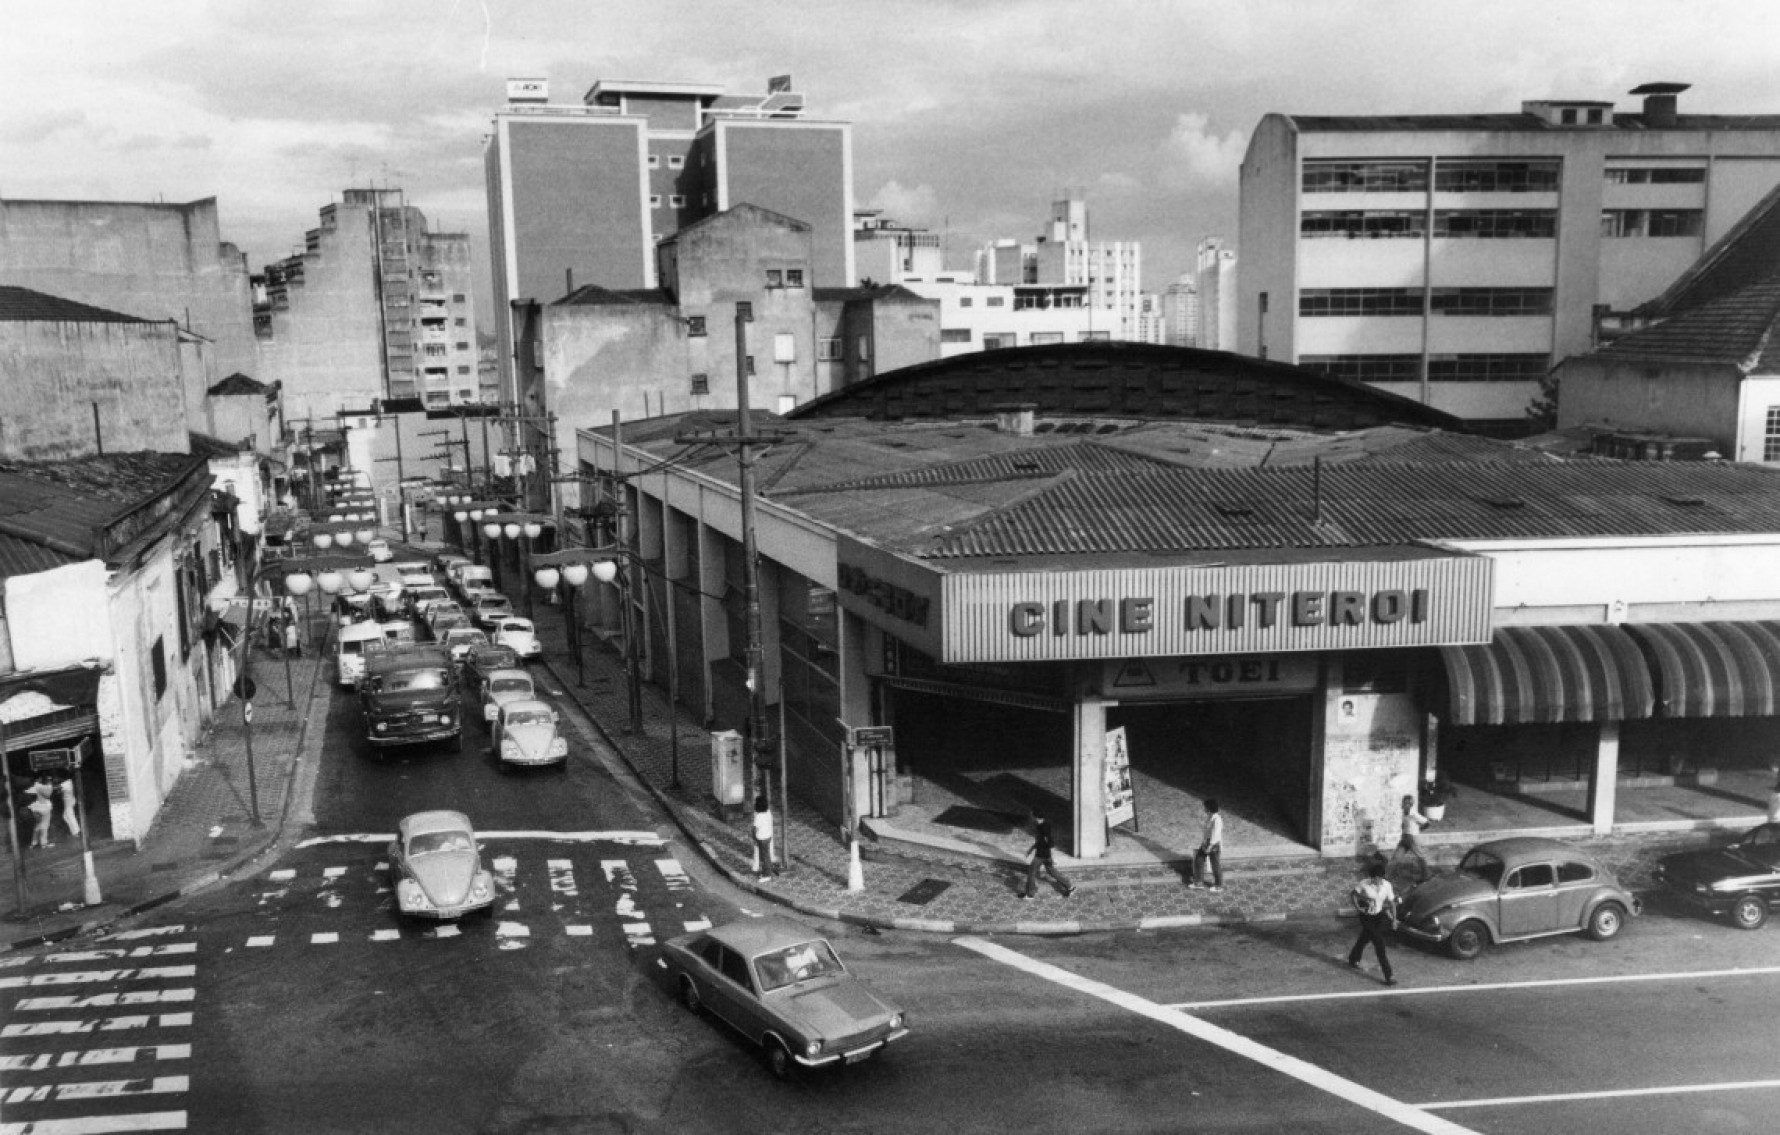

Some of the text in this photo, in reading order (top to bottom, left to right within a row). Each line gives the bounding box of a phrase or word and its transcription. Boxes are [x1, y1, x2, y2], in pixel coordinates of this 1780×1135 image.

[1010, 589, 1428, 636] CINE NITEROI
[1180, 660, 1280, 684] TOEI
